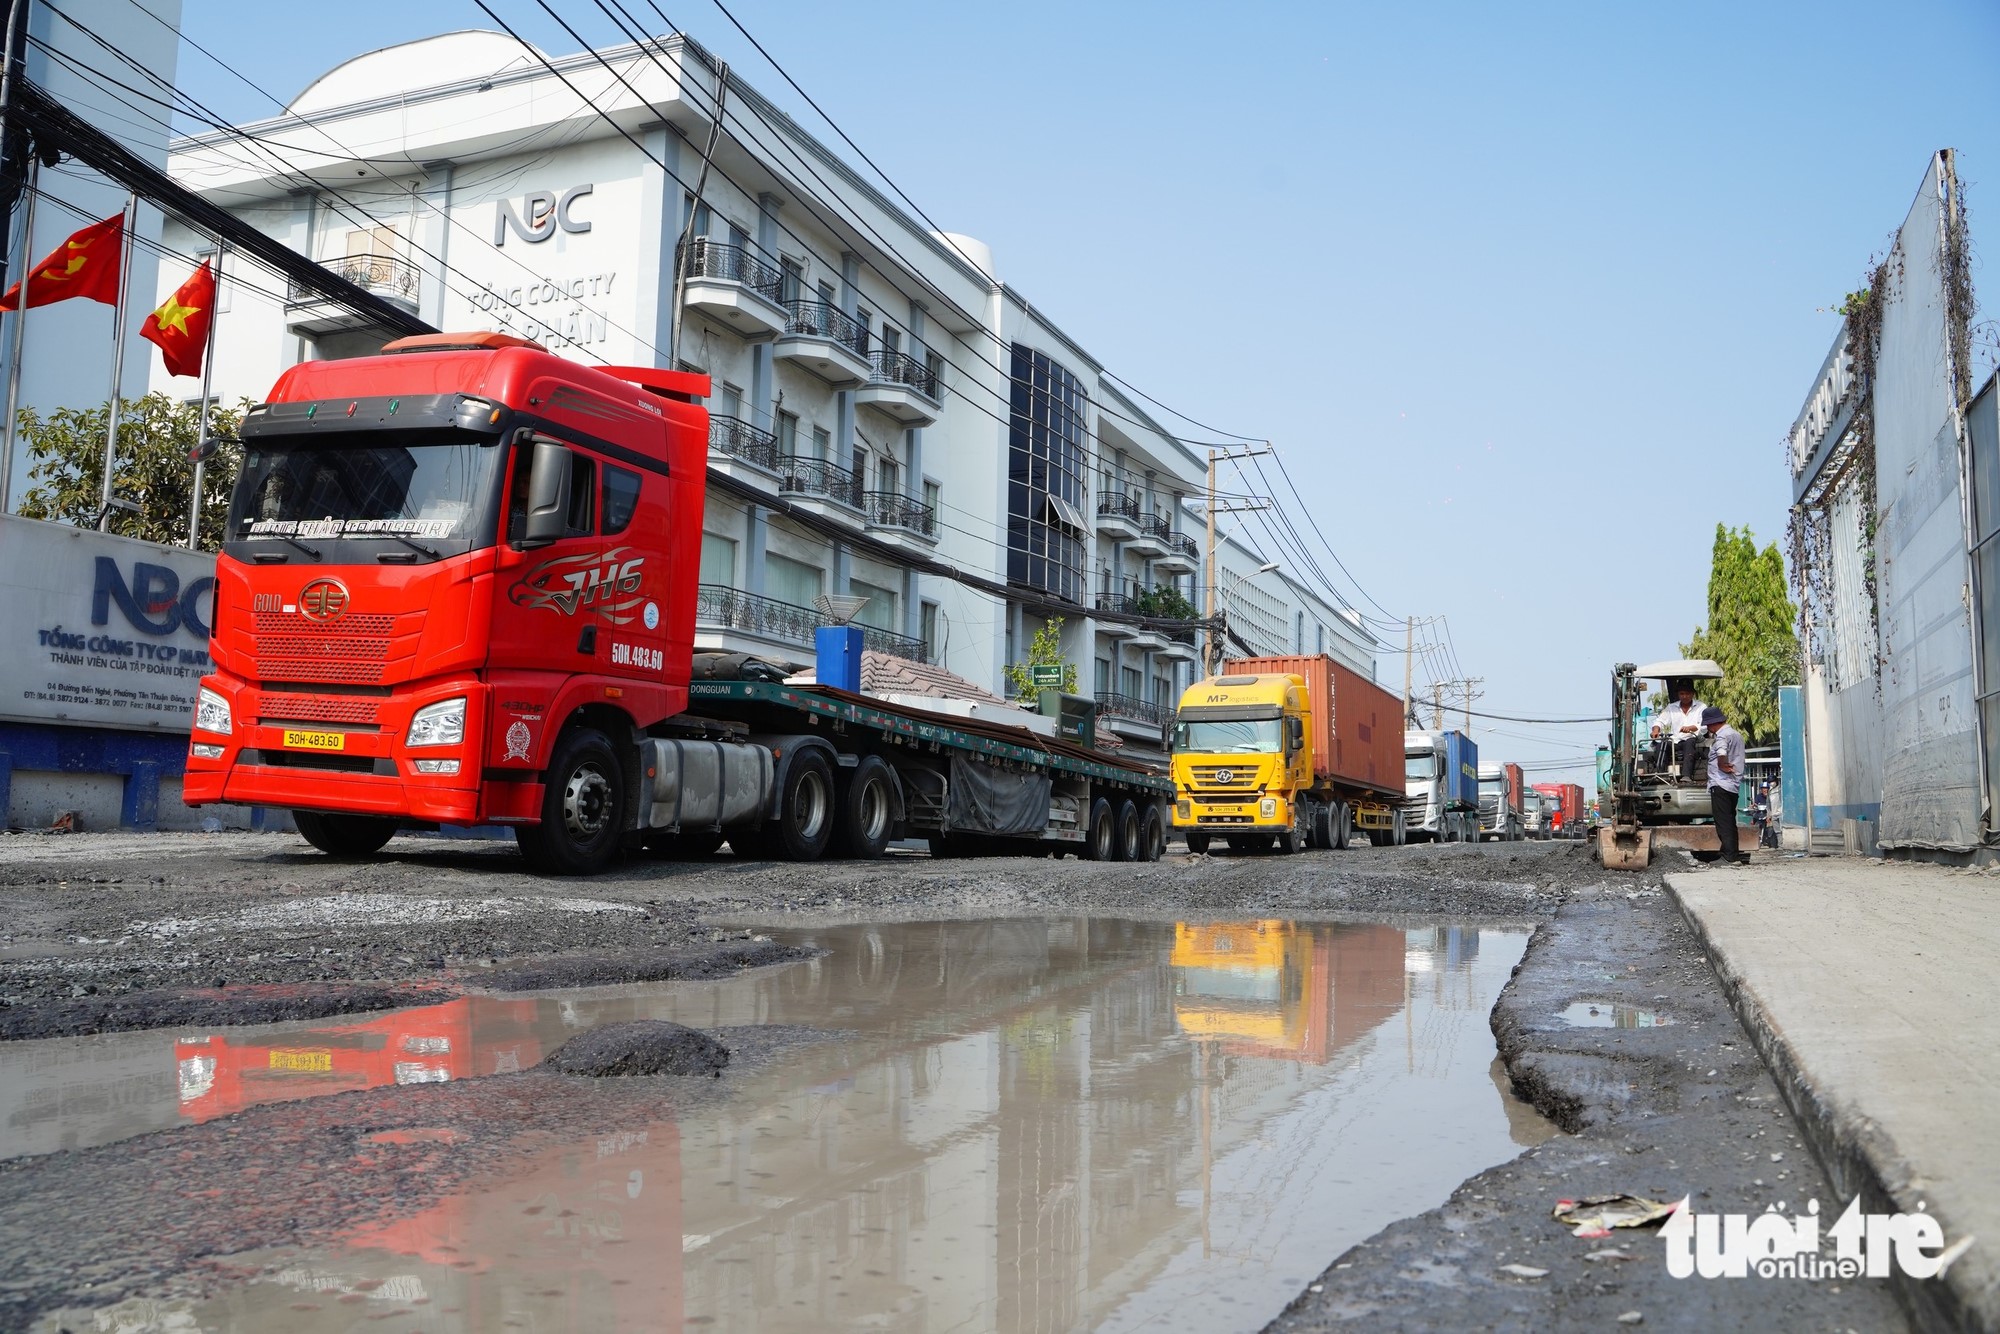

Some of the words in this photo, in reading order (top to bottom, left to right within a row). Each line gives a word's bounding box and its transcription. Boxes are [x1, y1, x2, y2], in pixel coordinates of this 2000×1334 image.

[494, 183, 594, 247] NBC
[467, 281, 522, 314] TỔNG
[526, 277, 584, 306] CÔNG
[589, 272, 617, 296] TY
[523, 304, 608, 348] PHẦN
[343, 519, 457, 539] TRANSPORT
[551, 557, 645, 616] JH6
[254, 593, 281, 612] GOLD
[38, 625, 86, 650] TỔNG
[88, 634, 133, 657] CÔNG
[178, 648, 209, 665] MAY
[612, 642, 663, 671] 50H.483.60
[50, 651, 84, 666] THÀNH
[87, 655, 107, 668] VIÊN
[110, 657, 128, 670] CỦA
[130, 660, 146, 673] TẬP
[146, 663, 172, 676] ĐOÀN
[173, 666, 190, 679] DỆT
[47, 682, 56, 691] 04
[58, 683, 80, 694] Đường
[81, 685, 93, 694] Bến
[113, 689, 136, 699] Phường
[138, 691, 149, 699] Tân
[150, 692, 168, 702] Thuận
[691, 684, 731, 694] DONGGUAN
[1207, 694, 1229, 703] MP
[288, 732, 339, 747] 50H-483.60
